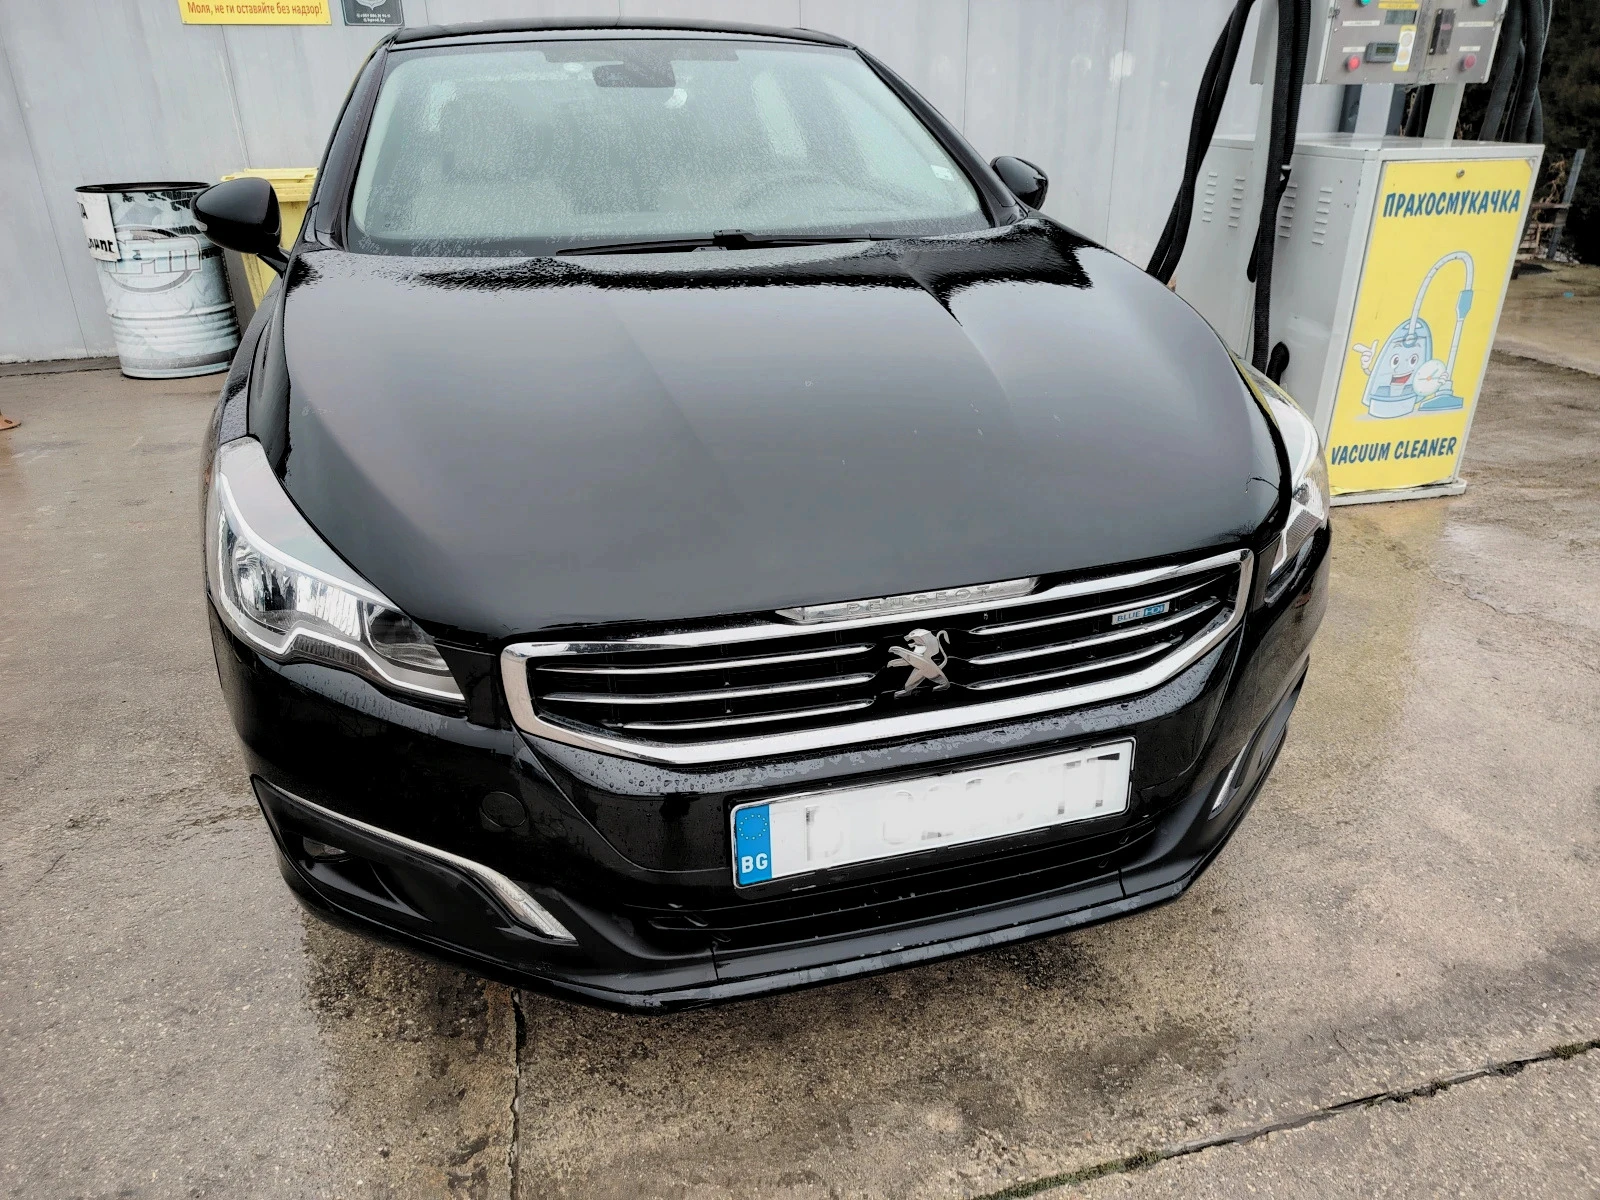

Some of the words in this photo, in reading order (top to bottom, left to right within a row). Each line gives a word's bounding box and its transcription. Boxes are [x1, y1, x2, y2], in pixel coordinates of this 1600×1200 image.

[187, 2, 213, 15] Моля,
[215, 4, 225, 14] не
[226, 5, 235, 14] ги
[236, 2, 275, 14] оставяйте
[276, 2, 291, 14] без
[291, 2, 323, 17] надзор!
[1383, 190, 1521, 218] ПРАХОСМУКАЧКА
[1331, 442, 1391, 465] VACUUM
[1394, 436, 1457, 460] CLEANER
[1117, 611, 1140, 621] BLUE
[741, 852, 768, 874] BG
